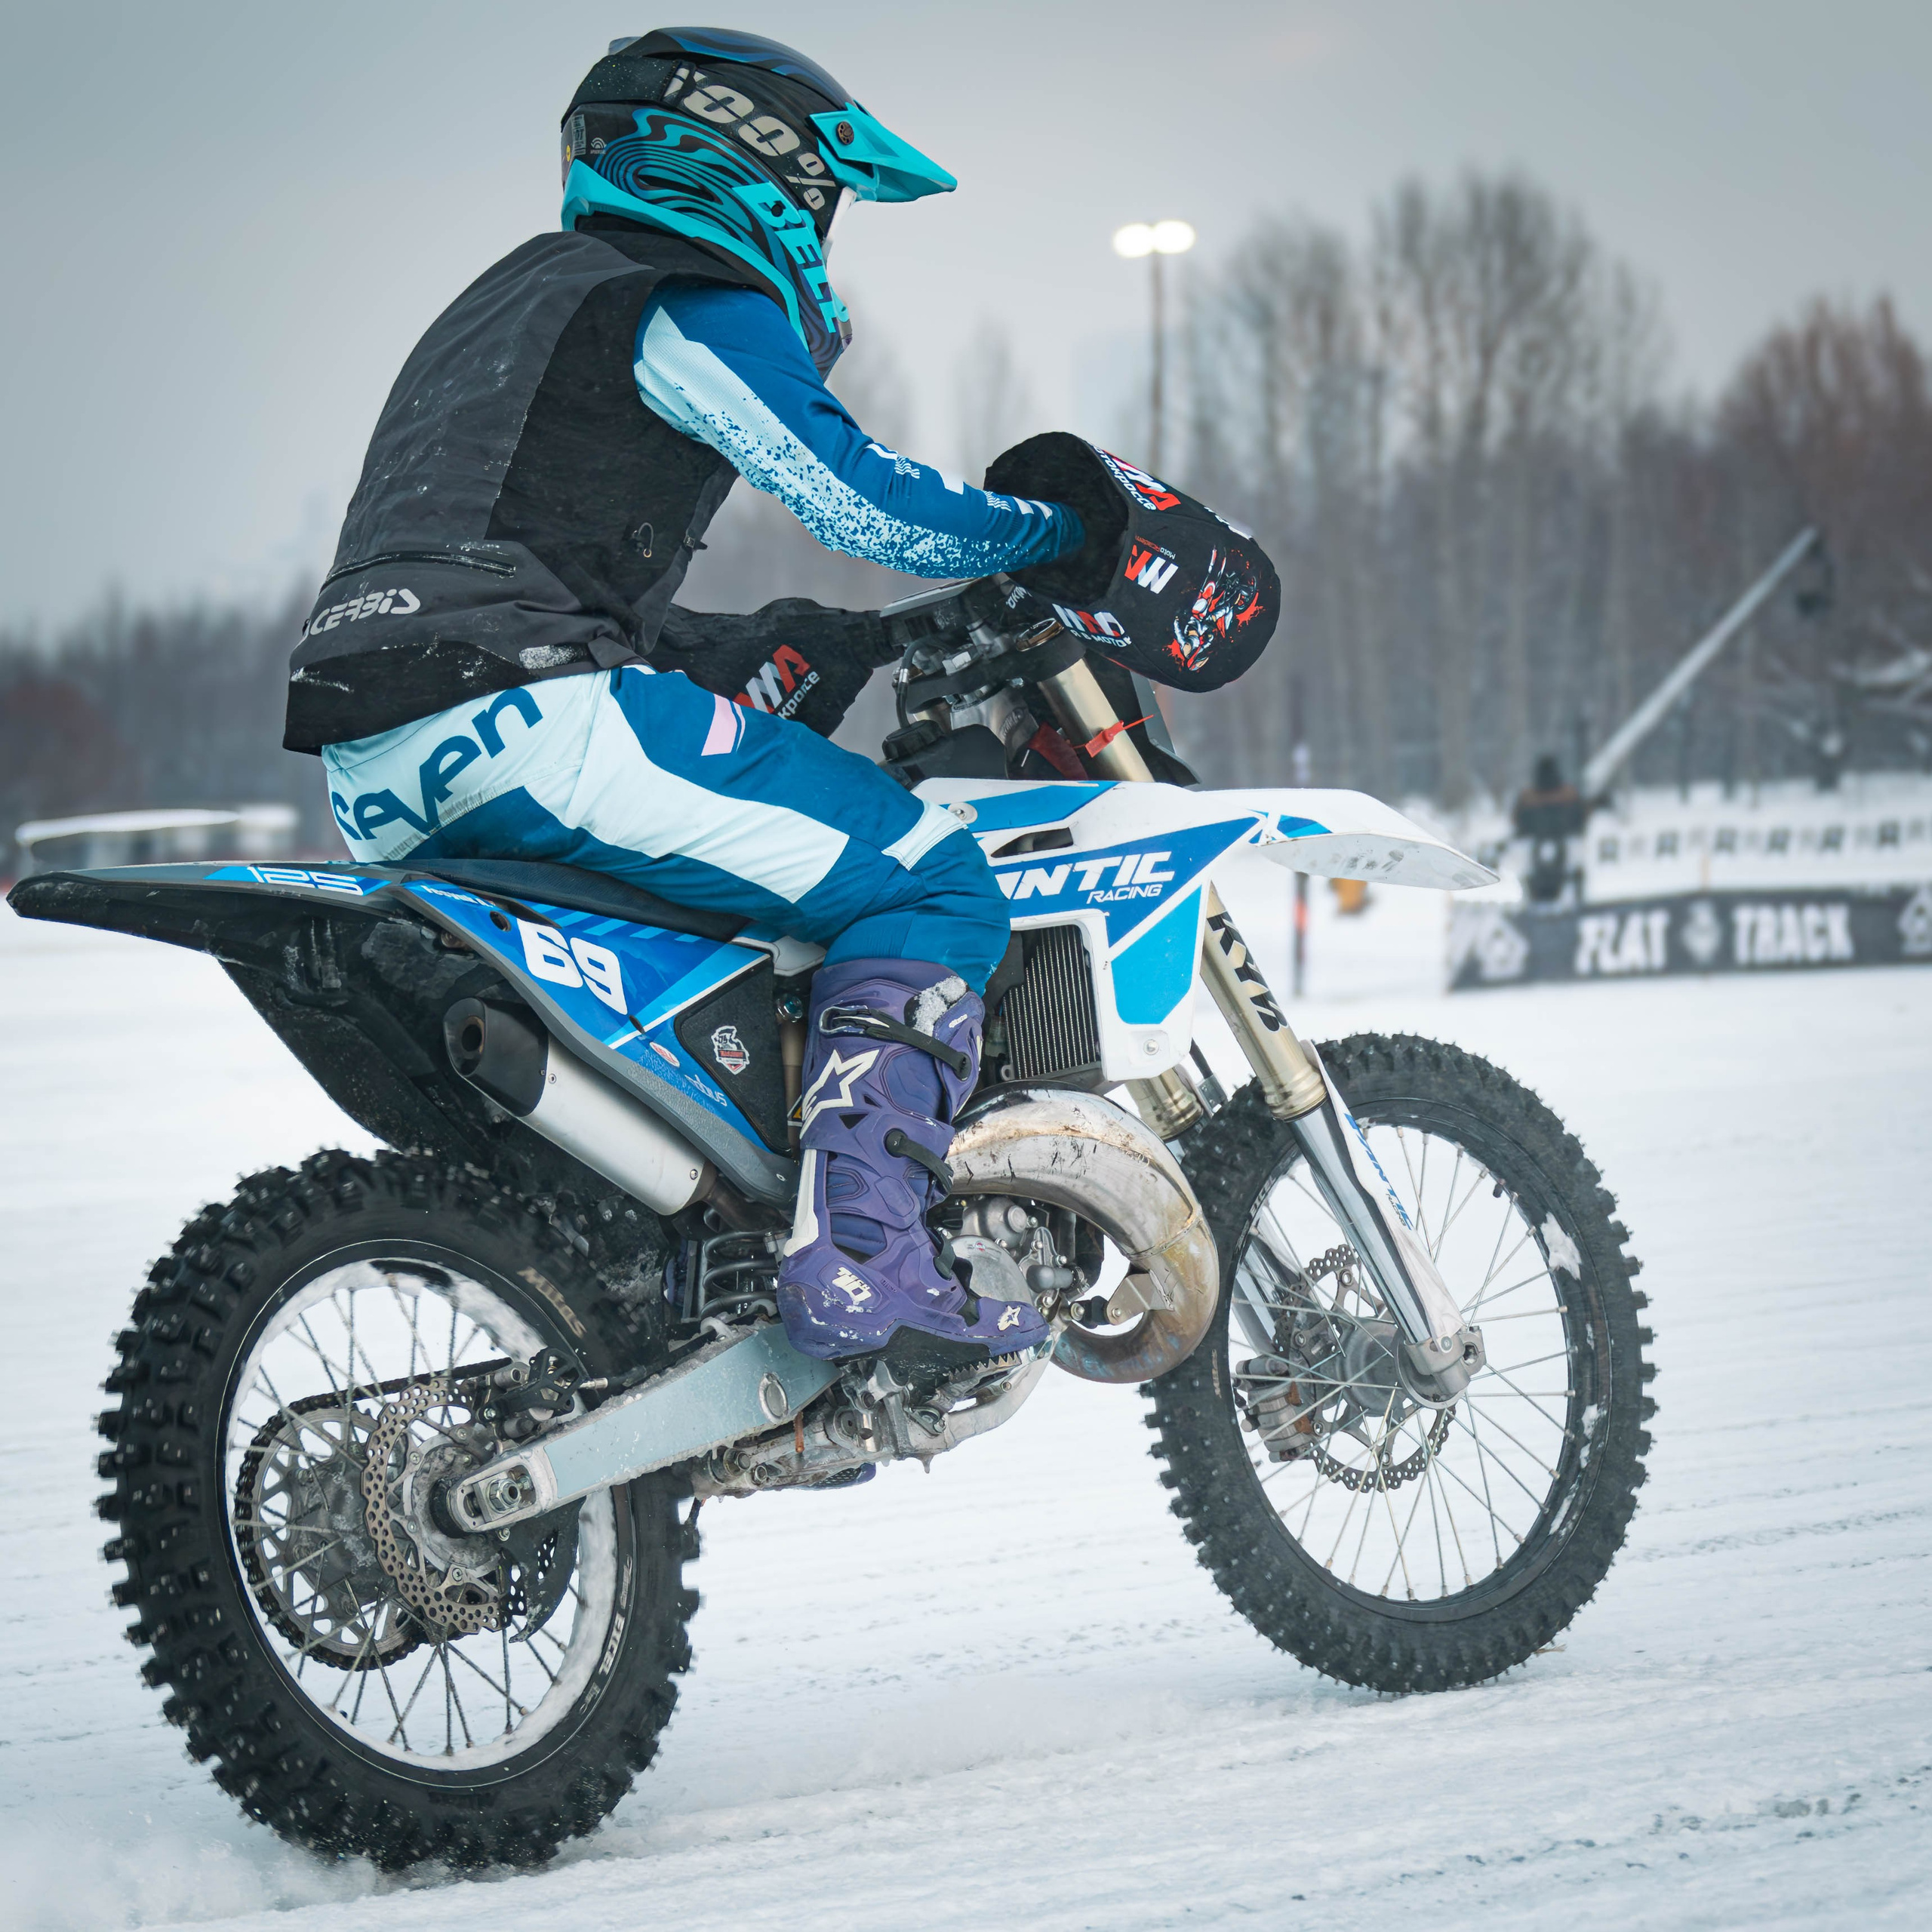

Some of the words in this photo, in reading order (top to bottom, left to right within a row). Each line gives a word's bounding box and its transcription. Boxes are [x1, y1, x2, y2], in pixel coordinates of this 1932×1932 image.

[731, 180, 850, 334] BELL
[302, 588, 421, 643] CERBIS
[247, 866, 364, 896] 125
[1086, 884, 1163, 904] RACING
[515, 919, 628, 1015] 69
[1576, 909, 1669, 974] FLAT
[1733, 904, 1854, 960] TRACK
